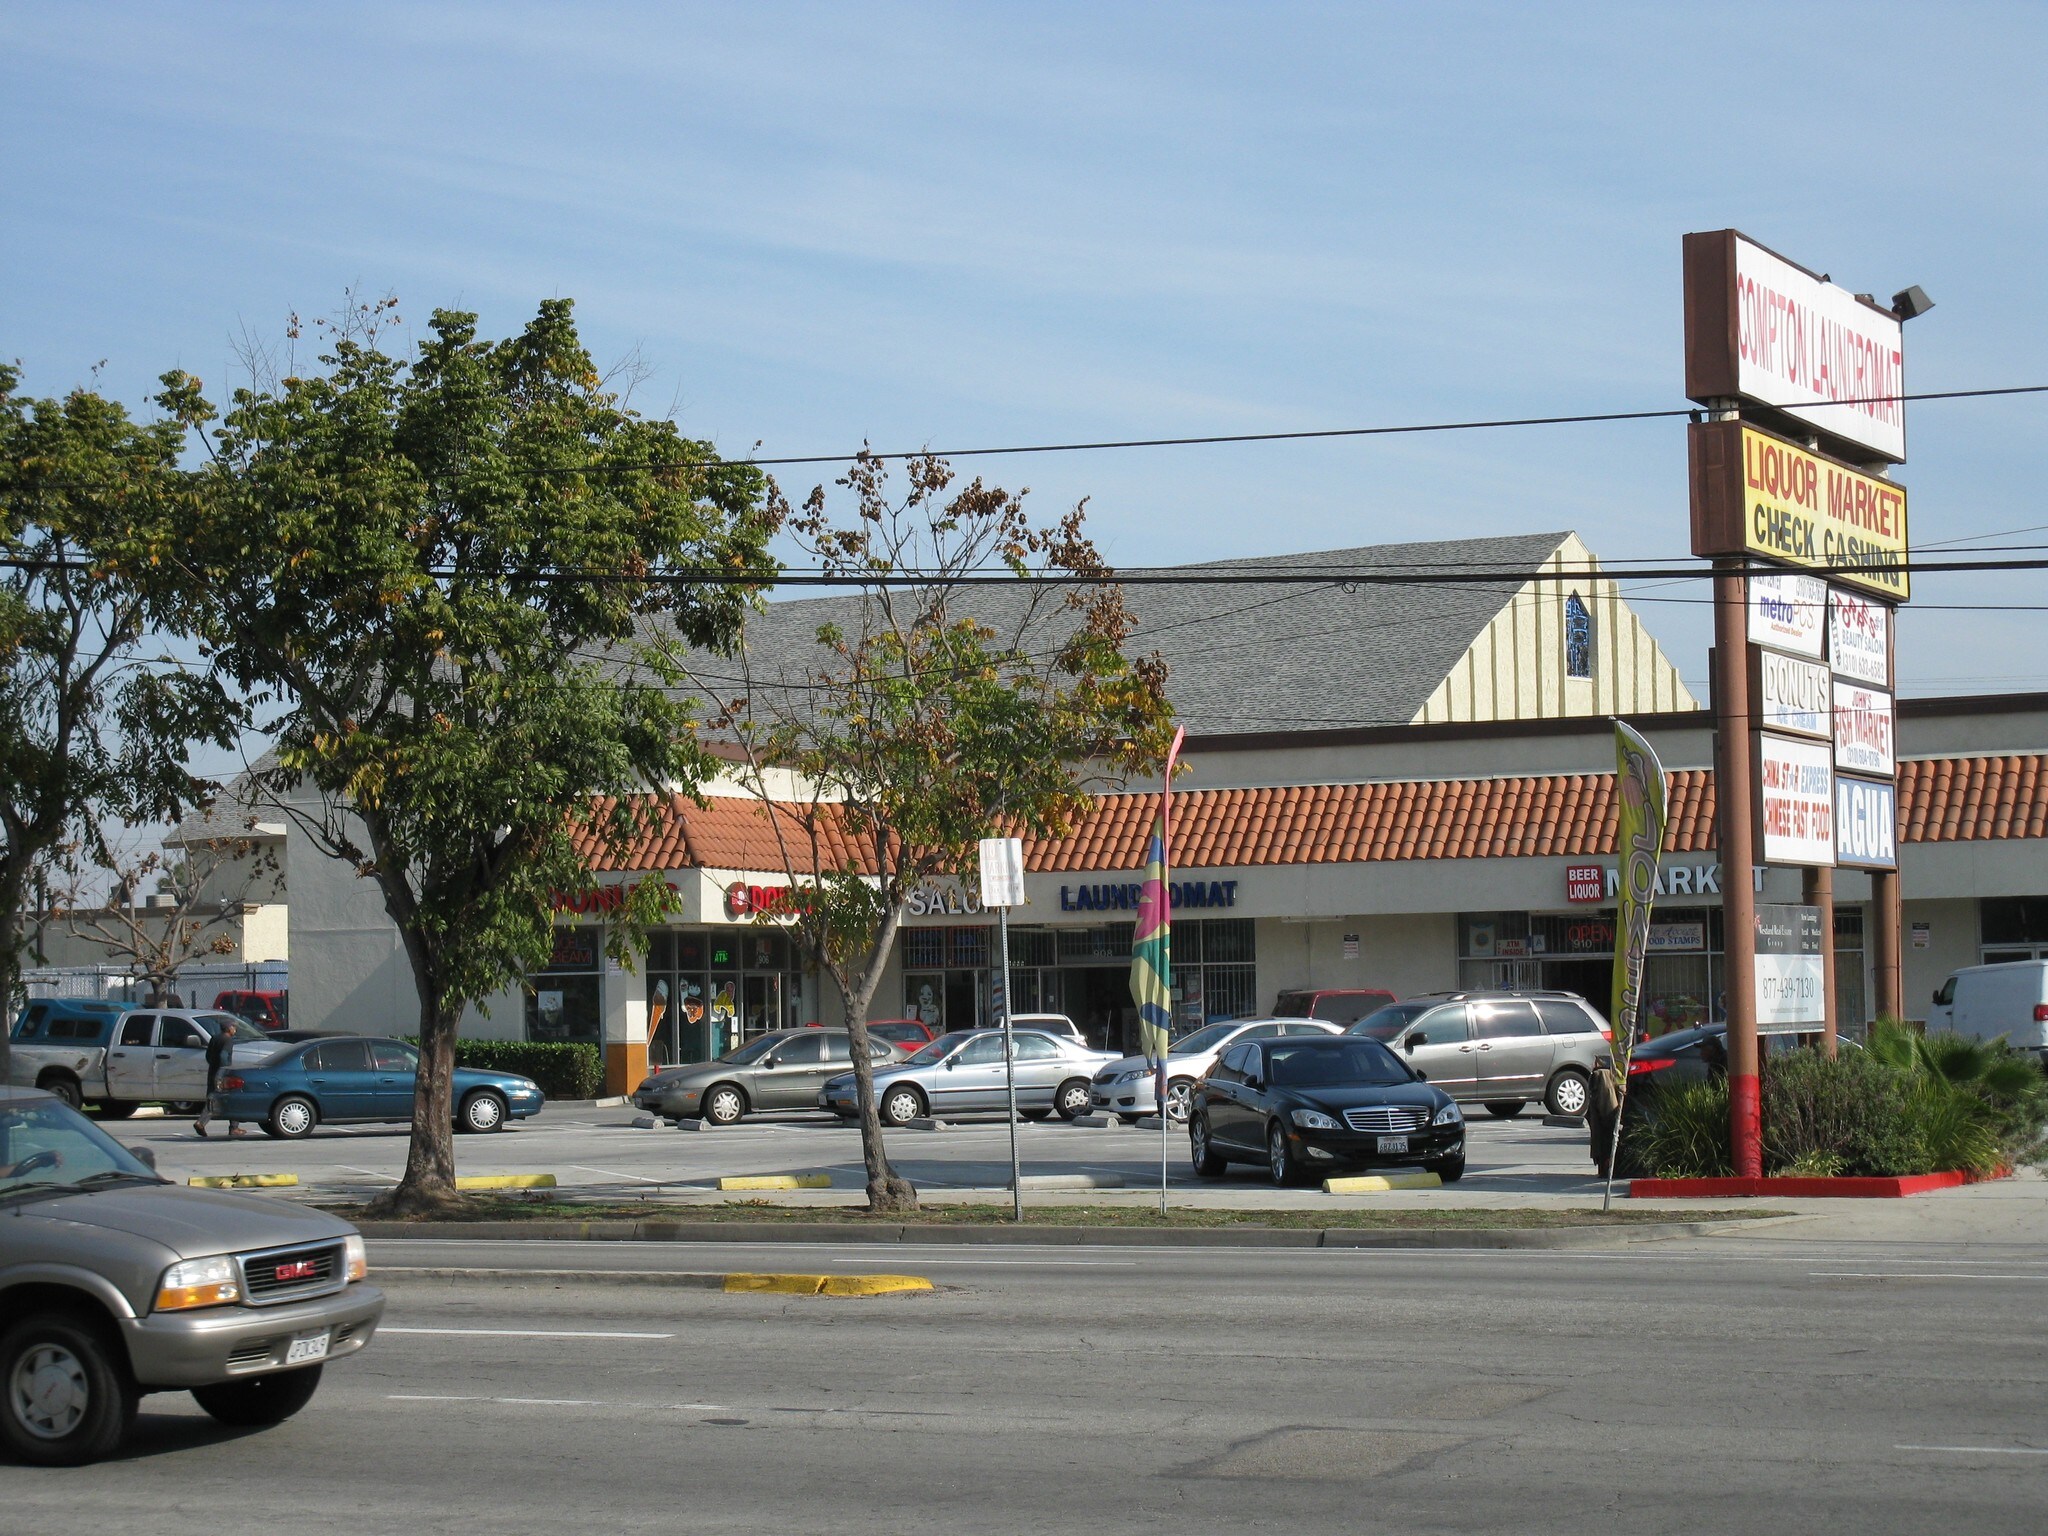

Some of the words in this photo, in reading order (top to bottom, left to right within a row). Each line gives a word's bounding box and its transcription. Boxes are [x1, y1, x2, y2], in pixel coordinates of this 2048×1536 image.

[1736, 271, 1807, 389] COMPTON
[1812, 310, 1901, 428] LAUNDROMAT
[1746, 436, 1818, 511] LIQUOR
[1827, 469, 1902, 540] MARKET
[1754, 503, 1815, 561] CHECK
[1824, 528, 1900, 588] CASHING
[1842, 628, 1864, 650] BEAUTY
[1864, 635, 1884, 655] SALON
[1764, 654, 1828, 714] DONUTS
[1852, 690, 1872, 710] JOHN'S
[1776, 705, 1788, 725] ICE
[1791, 708, 1817, 730] CREAM
[1834, 704, 1853, 751] FISH
[1855, 709, 1890, 760] MARKET
[1763, 758, 1780, 789] CHINA
[1800, 765, 1829, 796] EXPRESS
[1763, 797, 1791, 838] CHINESE
[1793, 799, 1809, 841] FAST
[1812, 802, 1830, 842] FOOD
[1838, 783, 1894, 859] AGUA
[1569, 868, 1598, 881] BEER
[1606, 865, 1768, 897] ARKT
[909, 888, 989, 916] SALO
[1060, 880, 1238, 911] LAUNDOMAT
[1569, 883, 1600, 899] LIQUOR
[1506, 940, 1520, 948] ATM
[1568, 925, 1613, 942] OPEN
[1573, 938, 1592, 950] 910
[1648, 937, 1665, 945] OOD
[1668, 936, 1700, 945] STAMPS
[549, 950, 591, 963] REAM
[1093, 949, 1113, 958] 908
[1502, 948, 1524, 956] INSIDE
[1763, 977, 1815, 999] 877-439-7130
[275, 1261, 316, 1280] GMC
